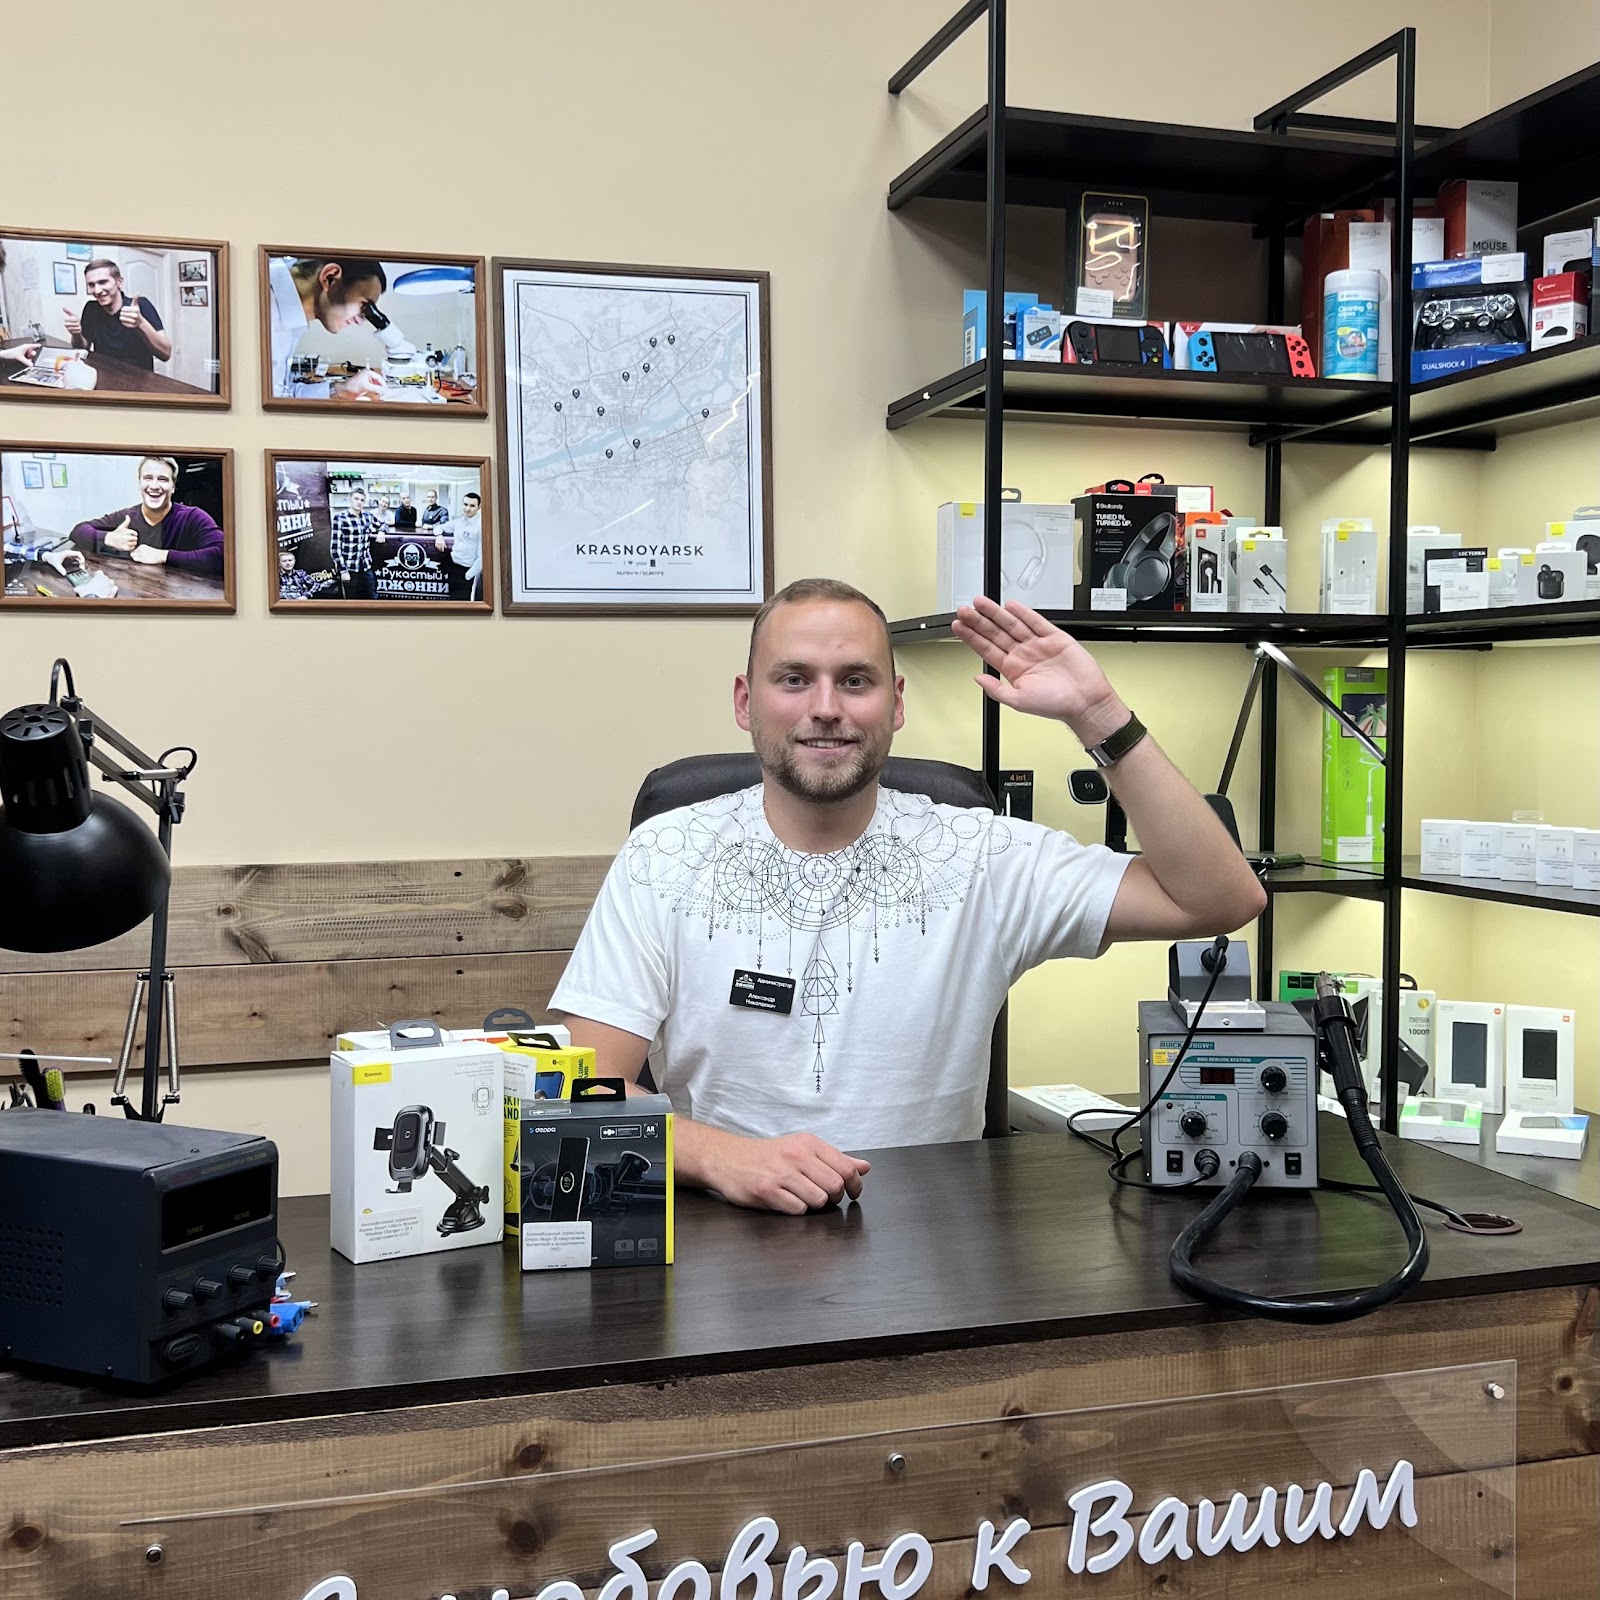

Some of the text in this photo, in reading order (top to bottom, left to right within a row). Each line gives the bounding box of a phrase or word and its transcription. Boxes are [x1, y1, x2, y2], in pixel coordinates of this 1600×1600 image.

[1473, 242, 1507, 251] MOUSE
[1422, 362, 1460, 370] DUALSHOCK
[576, 544, 704, 556] KRASNOYARSK
[382, 567, 442, 580] Рукастый
[376, 579, 449, 593] ДЖОННИ
[972, 1518, 1031, 1590] к
[1068, 1460, 1418, 1574] Вашим
